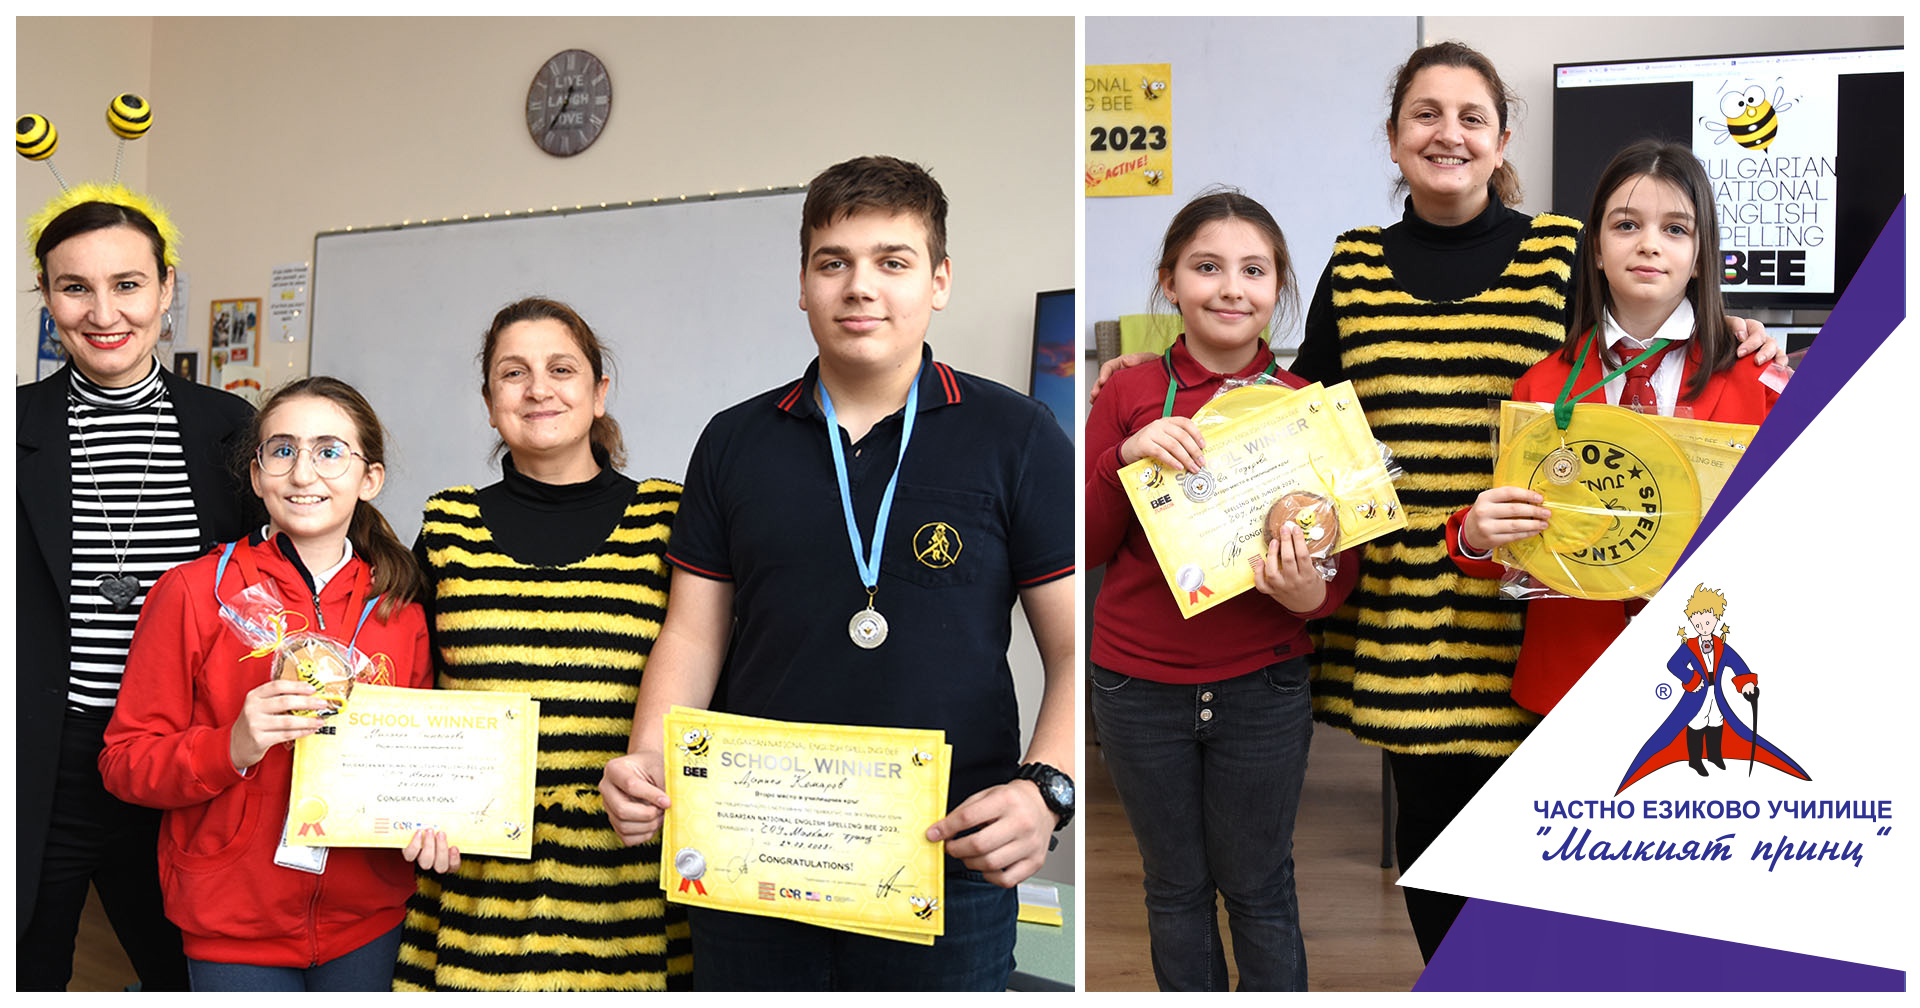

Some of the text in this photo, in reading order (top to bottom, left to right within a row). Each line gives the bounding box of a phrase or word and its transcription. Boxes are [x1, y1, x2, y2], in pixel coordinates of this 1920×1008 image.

[555, 74, 585, 89] LIVE
[1101, 95, 1134, 112] BEE
[1089, 125, 1167, 152] 2023
[1104, 154, 1148, 181] ACTIVE!
[1712, 179, 1829, 202] ATIONAL
[1718, 225, 1825, 248] PELLING
[1719, 250, 1806, 286] BEE
[1243, 417, 1310, 456] WINNER
[1582, 444, 1625, 470] 20
[1580, 473, 1625, 492] JUN
[1150, 493, 1173, 510] BEE
[348, 712, 499, 729] SCHOOL WINNER
[683, 765, 708, 779] BEE
[720, 750, 903, 780] SCHOOL WINNER
[717, 811, 756, 821] BULGARIAN
[757, 815, 793, 825] NATIONAL
[794, 818, 826, 827] ENGLISH
[827, 820, 862, 830] SPELLING
[864, 824, 878, 832] BEE
[758, 853, 855, 872] CONGRATULATIONS!
